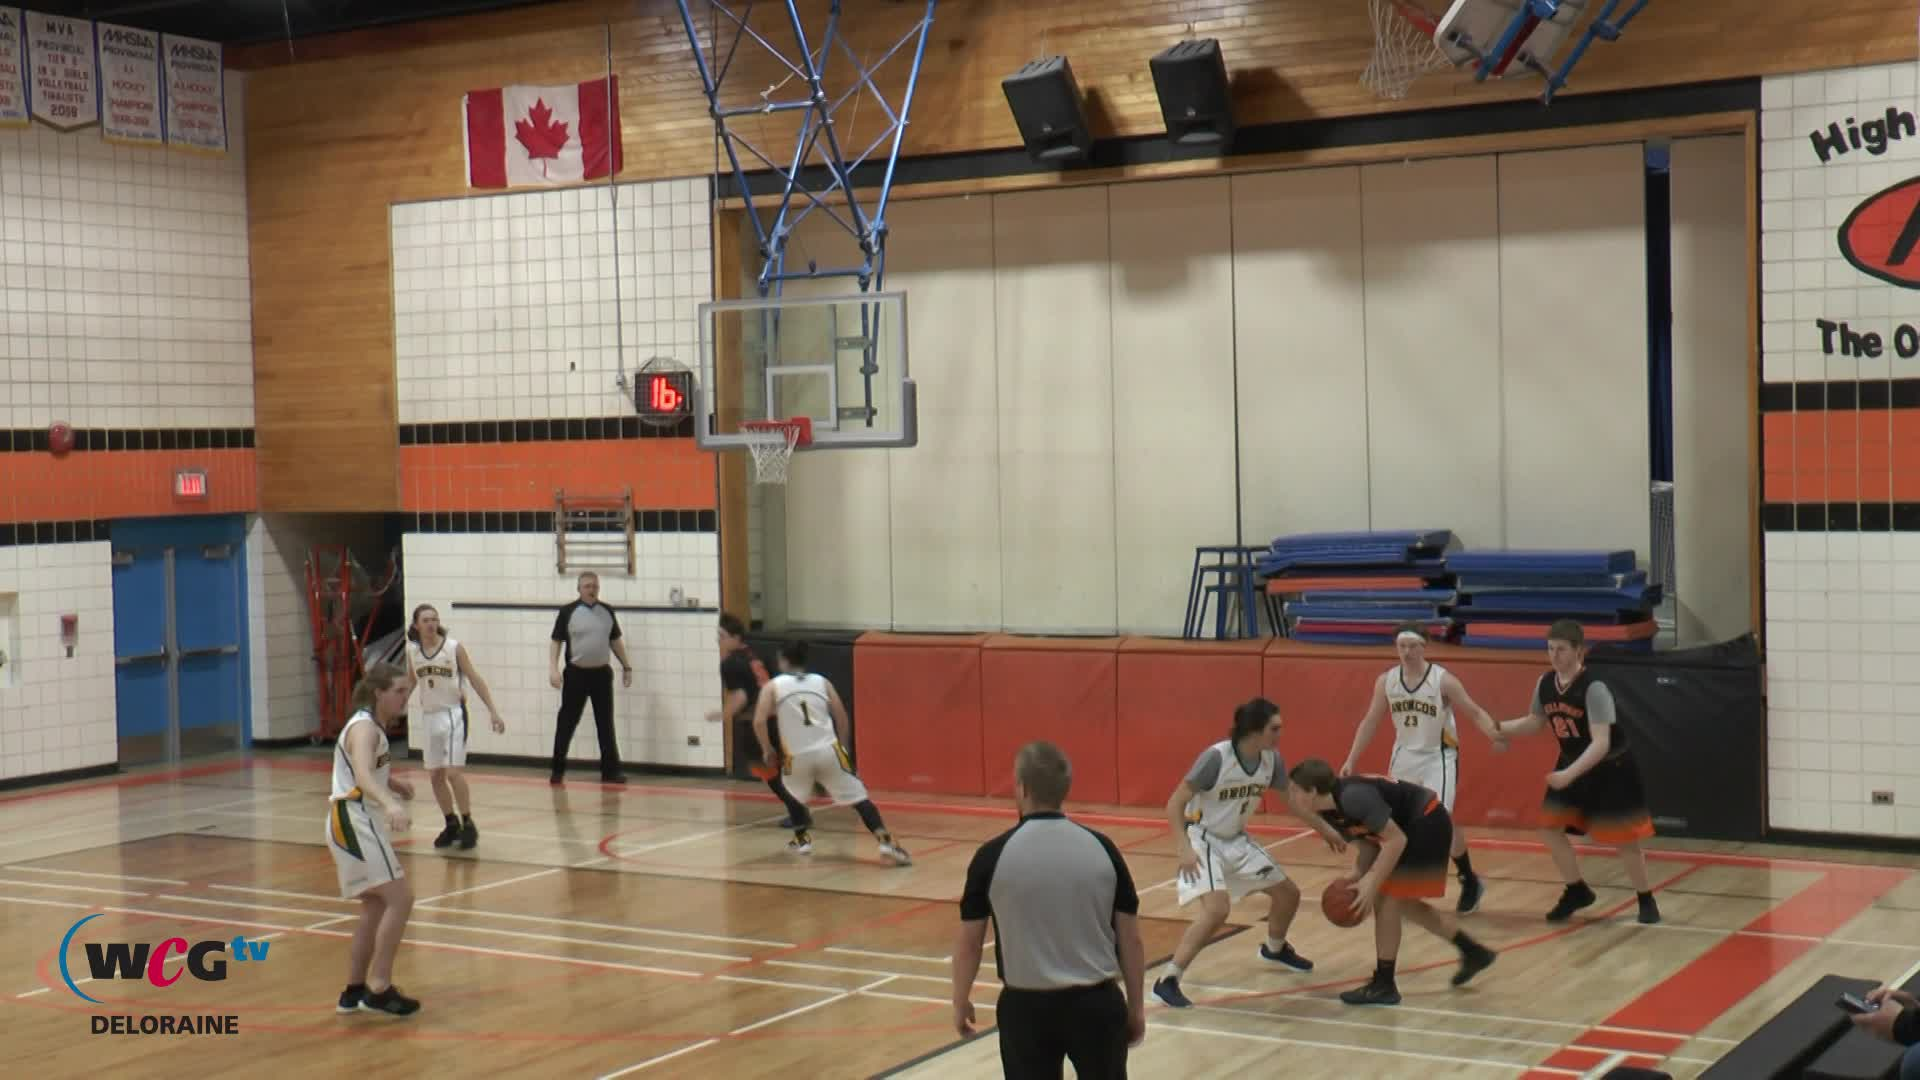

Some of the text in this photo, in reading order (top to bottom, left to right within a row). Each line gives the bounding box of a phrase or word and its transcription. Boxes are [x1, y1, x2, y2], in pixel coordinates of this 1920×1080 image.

[1809, 106, 1916, 164] High
[1816, 318, 1920, 359] The O
[801, 701, 815, 728] 1
[1404, 715, 1418, 728] 23
